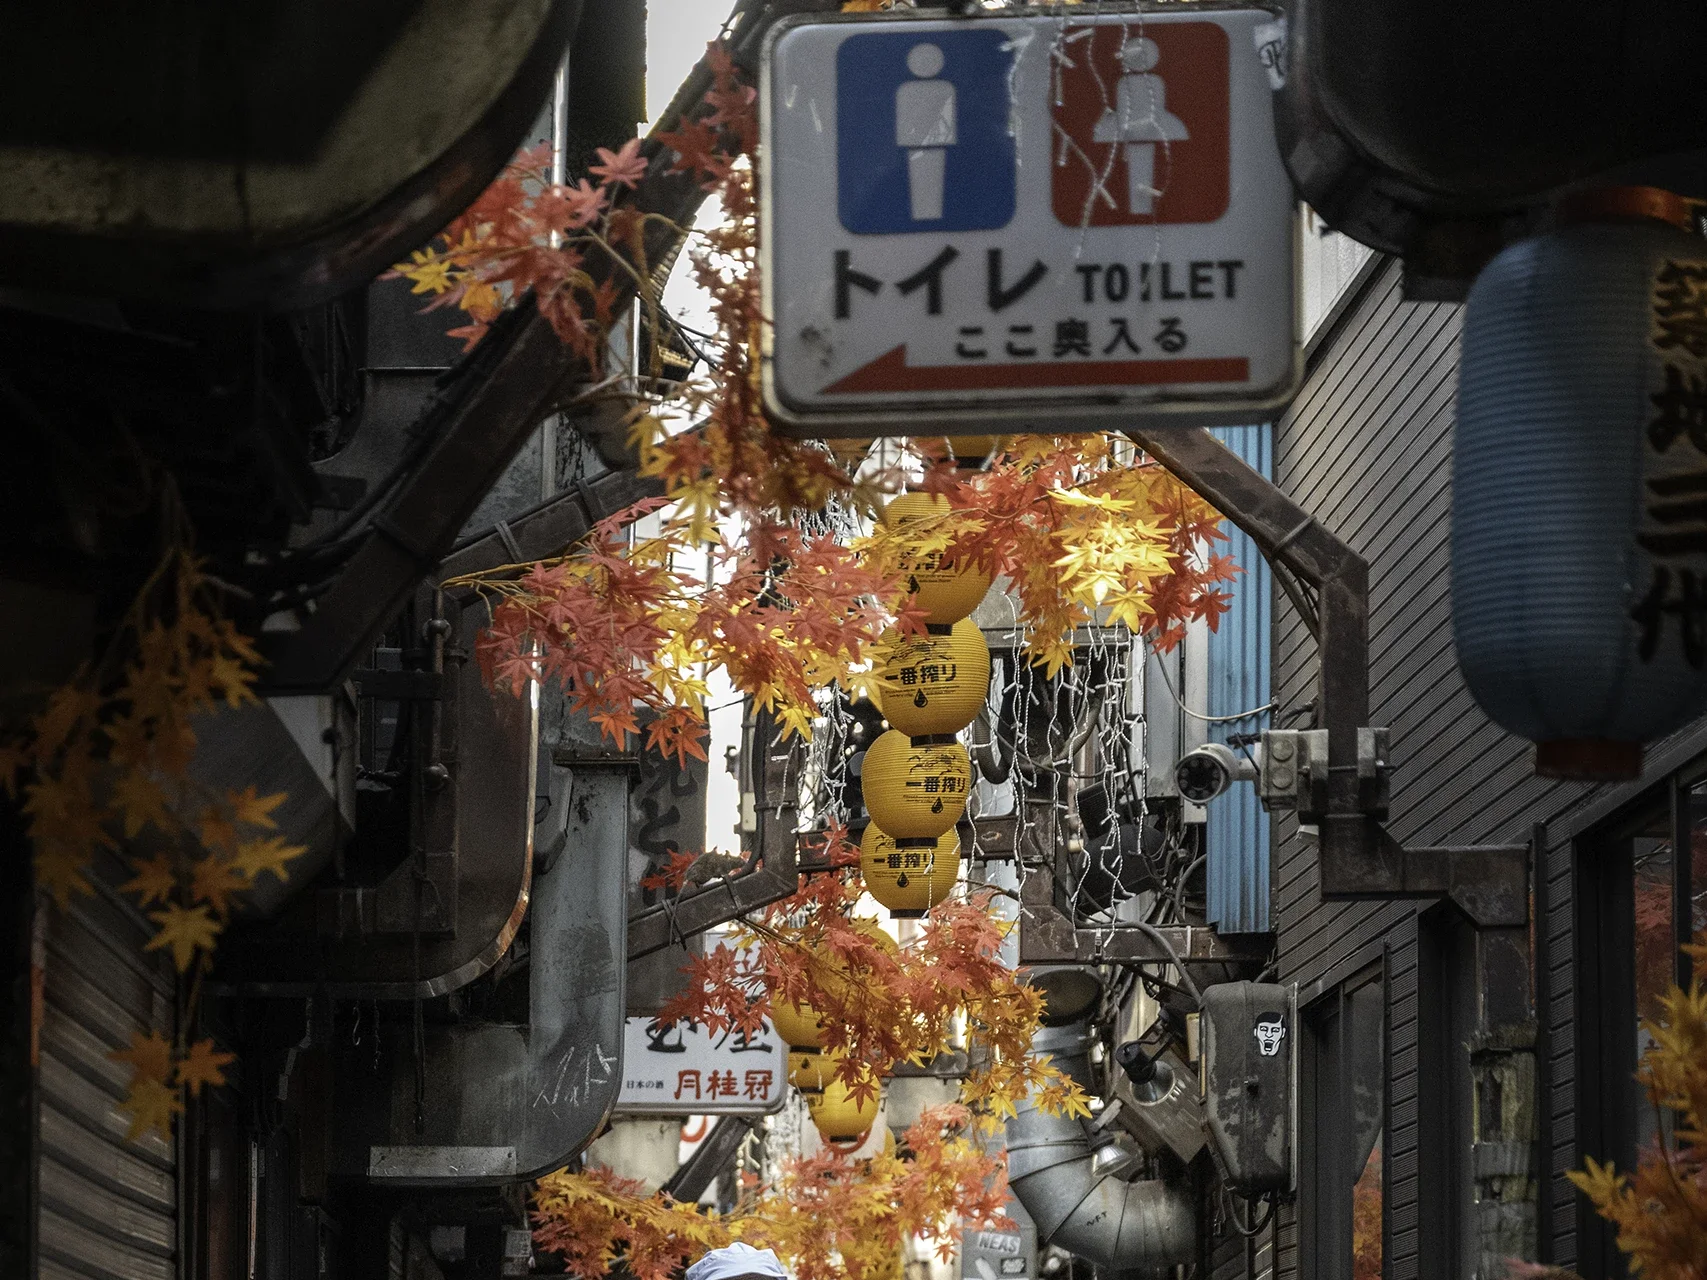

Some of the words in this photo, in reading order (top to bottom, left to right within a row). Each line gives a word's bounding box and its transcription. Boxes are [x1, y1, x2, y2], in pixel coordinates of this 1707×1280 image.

[832, 246, 1048, 320] トイレ
[1075, 260, 1245, 303] TOILET
[956, 319, 1189, 359] ここ奥入る
[885, 664, 956, 684] 一番搾り
[906, 776, 965, 793] 一番搾り
[873, 853, 934, 868] 一番搾り
[627, 1080, 665, 1090] 日本の酒
[674, 1069, 773, 1101] 月桂冠
